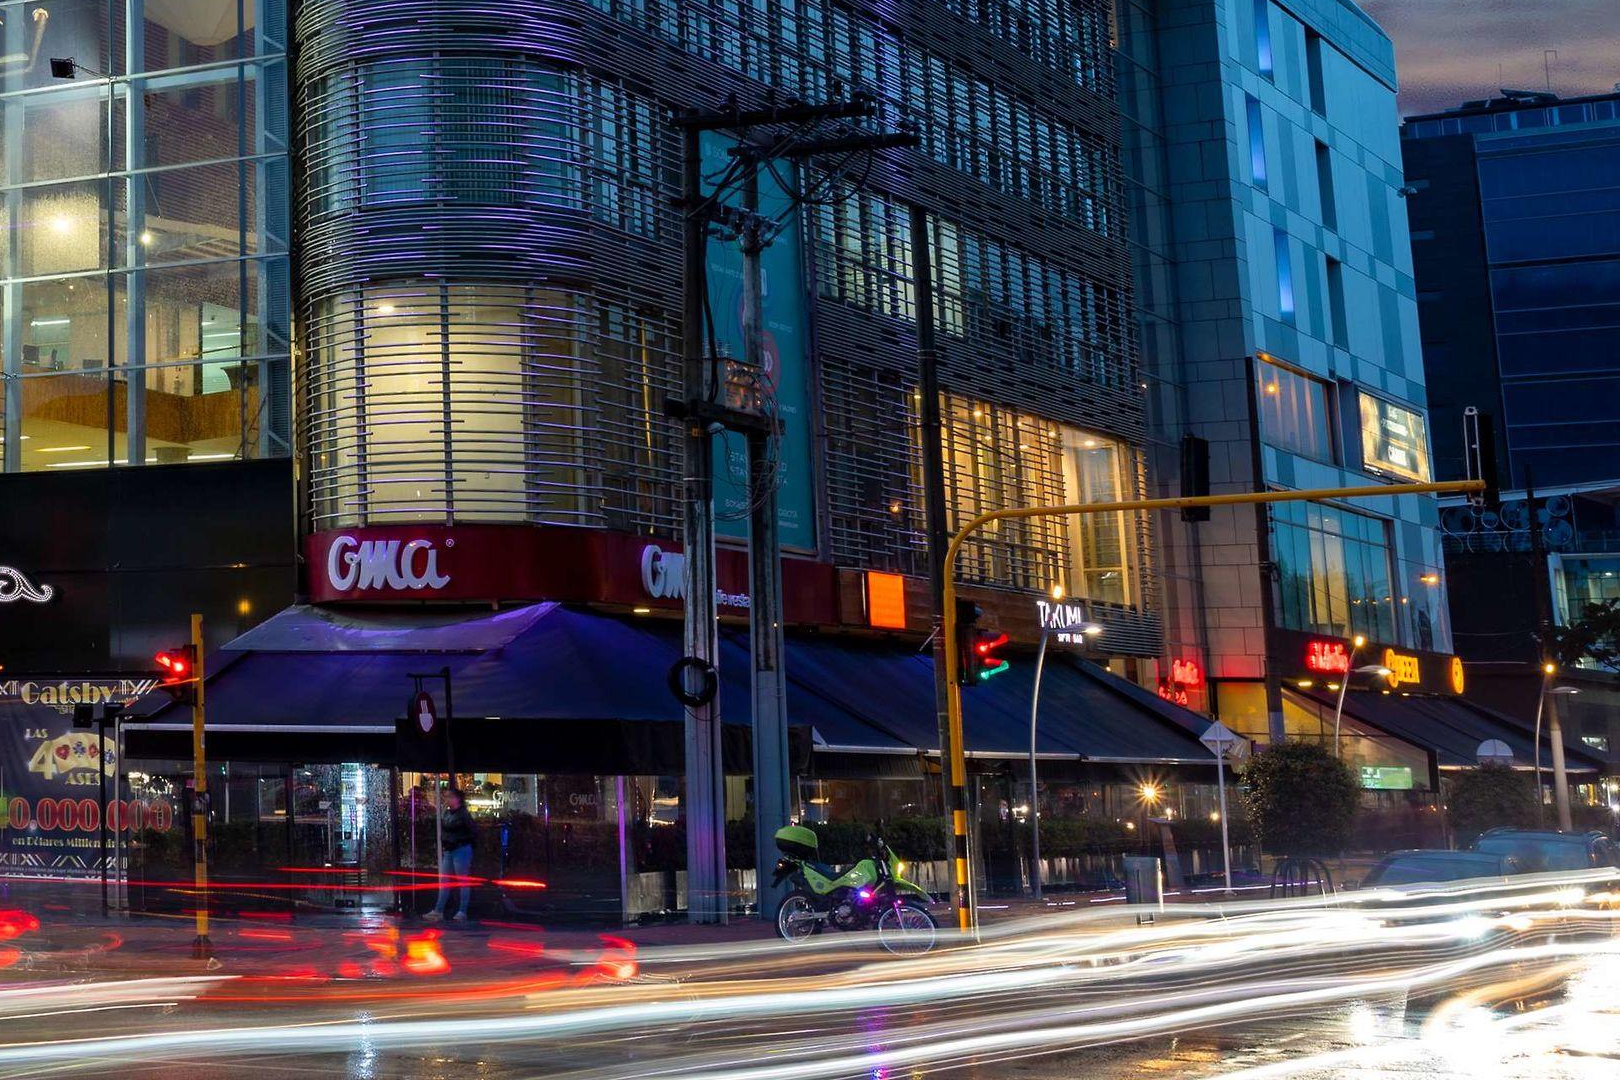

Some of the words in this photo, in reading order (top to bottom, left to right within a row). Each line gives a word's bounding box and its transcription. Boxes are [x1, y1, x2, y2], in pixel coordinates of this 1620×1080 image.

[20, 680, 117, 705] Gatsby
[25, 728, 48, 739] LAS
[28, 740, 54, 780] 4
